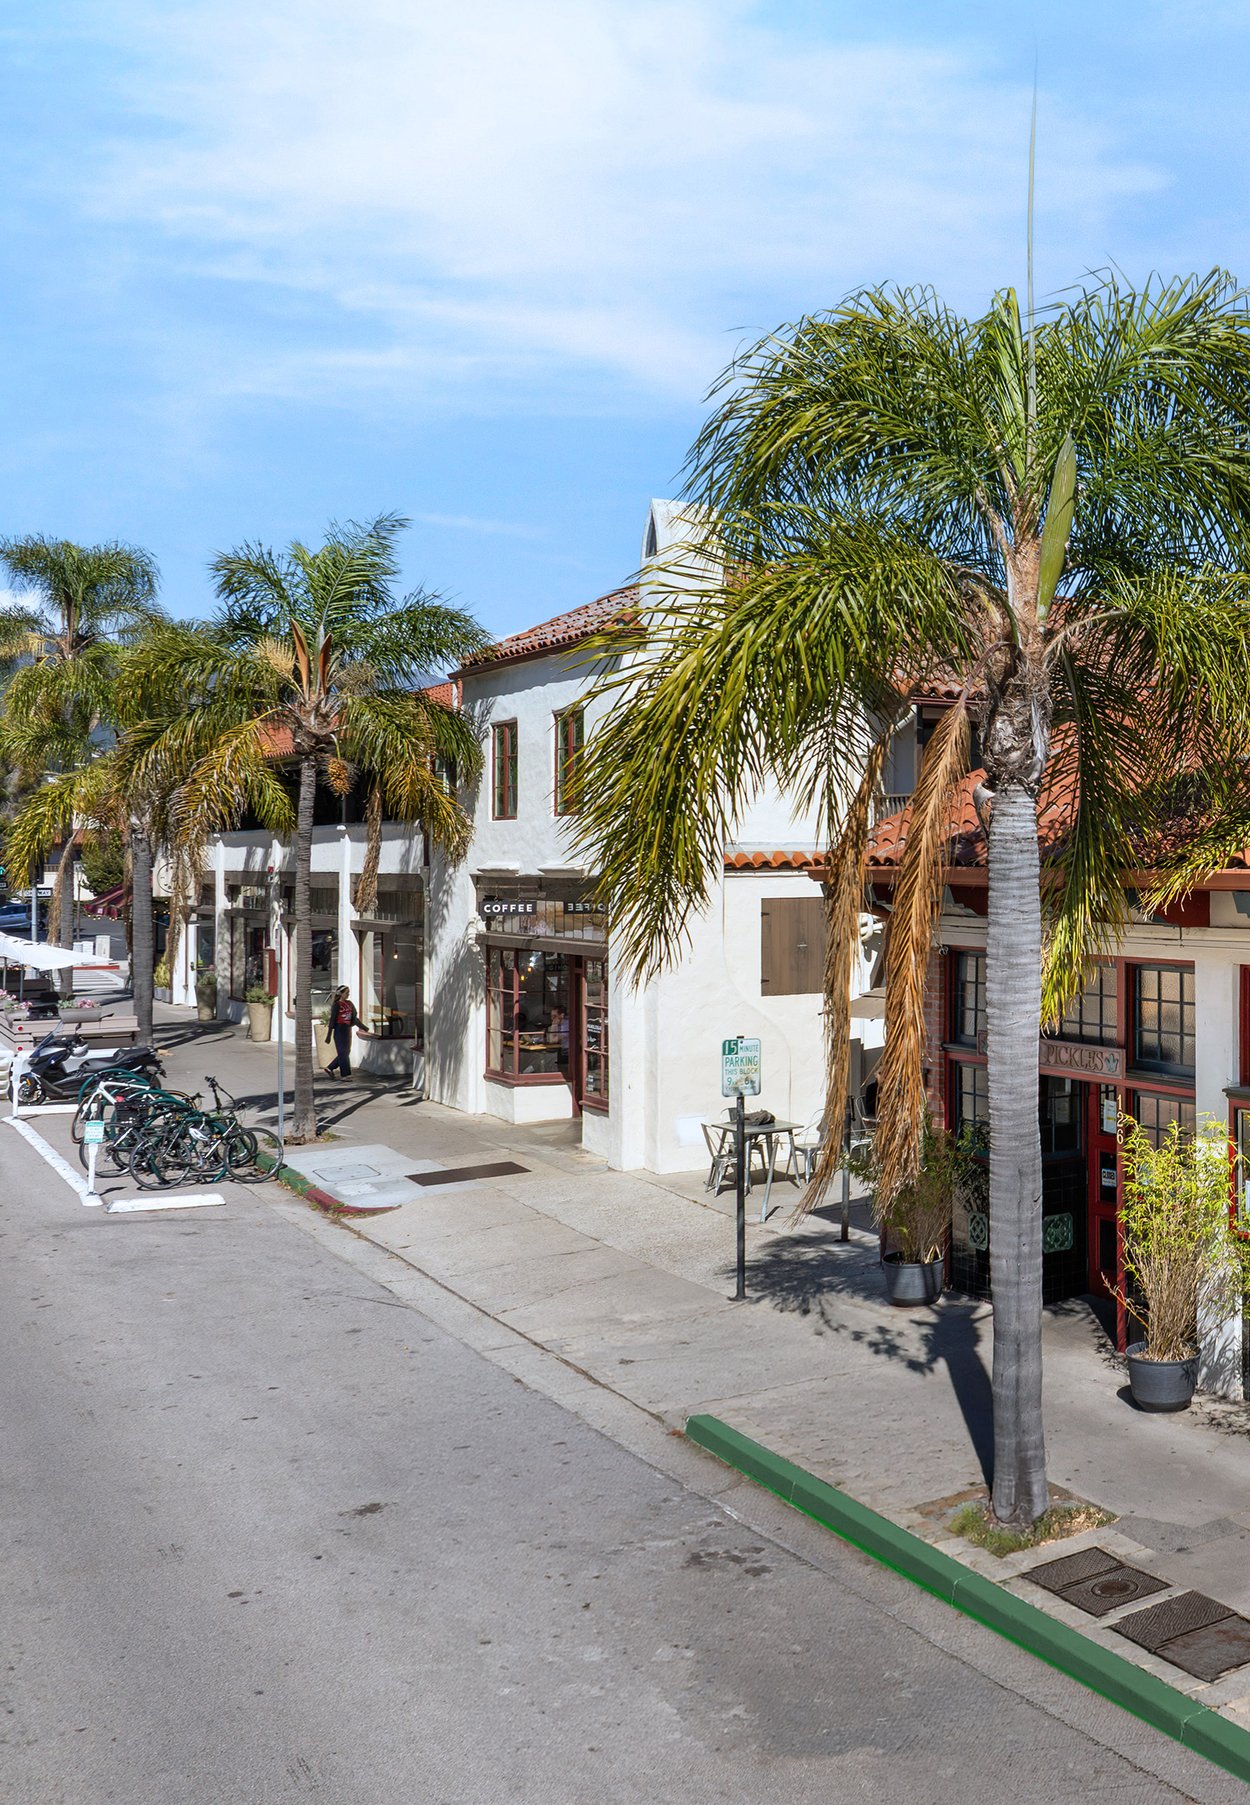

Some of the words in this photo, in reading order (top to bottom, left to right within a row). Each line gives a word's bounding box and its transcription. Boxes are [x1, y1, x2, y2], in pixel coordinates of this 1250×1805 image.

[484, 904, 533, 913] COFFEE
[725, 1041, 738, 1055] 15
[740, 1045, 759, 1053] MINUTE
[725, 1056, 758, 1067] PARKING
[1046, 1045, 1104, 1071] PICKLES
[739, 1067, 759, 1075] BLOCK
[1116, 1094, 1125, 1145] 126
